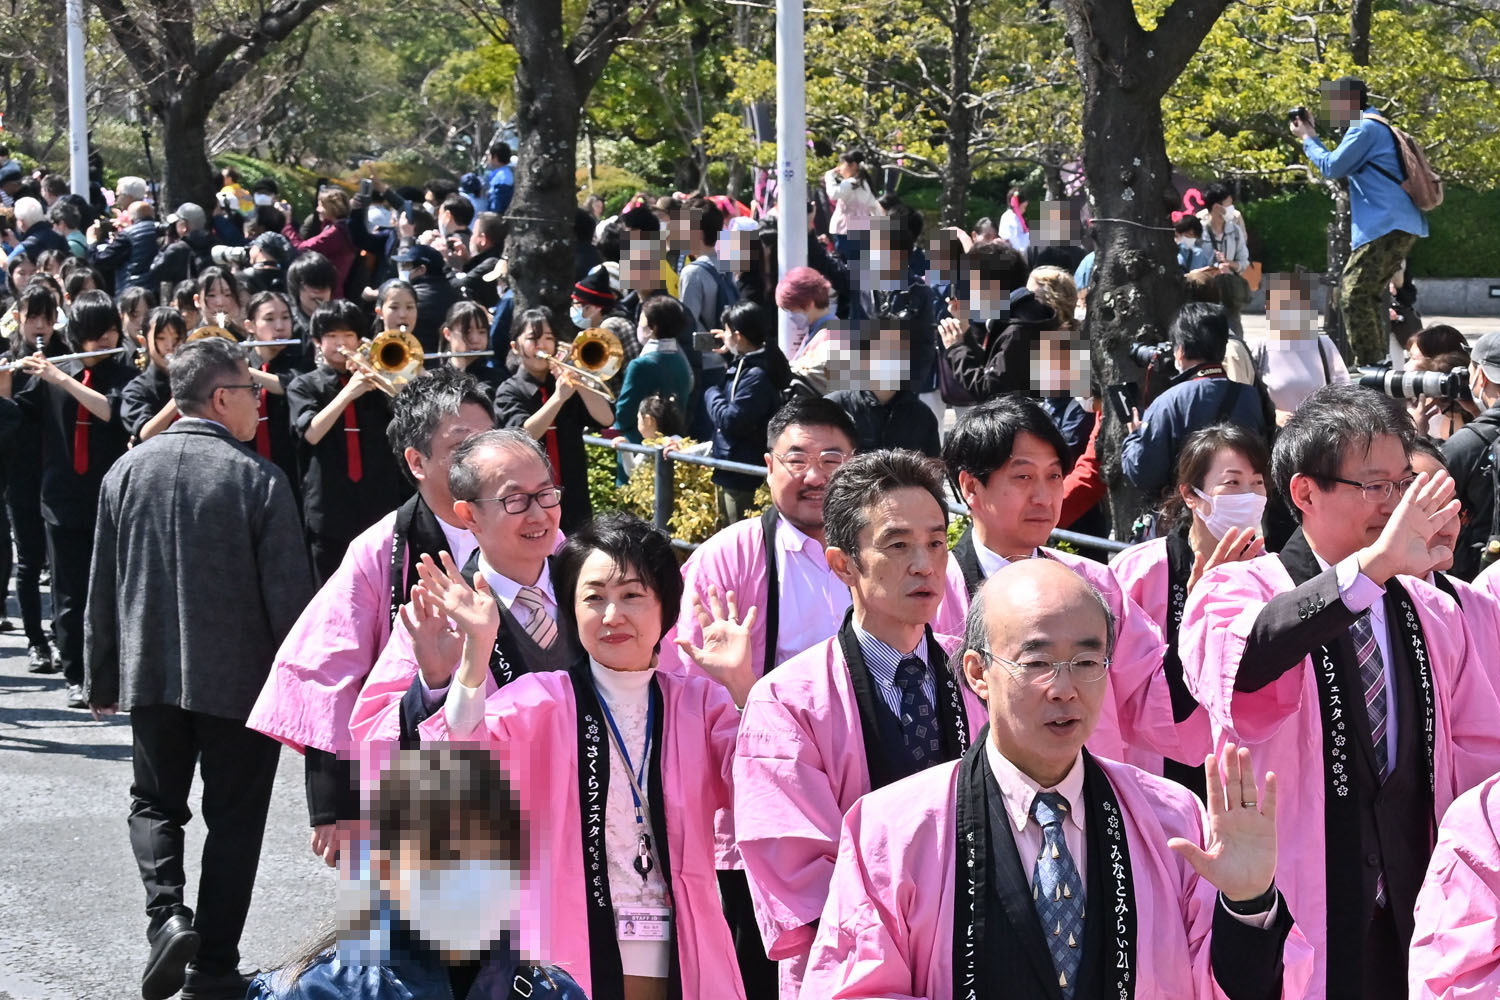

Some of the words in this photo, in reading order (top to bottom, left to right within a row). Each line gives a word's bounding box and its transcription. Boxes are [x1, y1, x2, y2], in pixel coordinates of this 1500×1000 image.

[586, 744, 601, 838] さくらフェスタ
[1110, 844, 1129, 969] みなとみらい21
